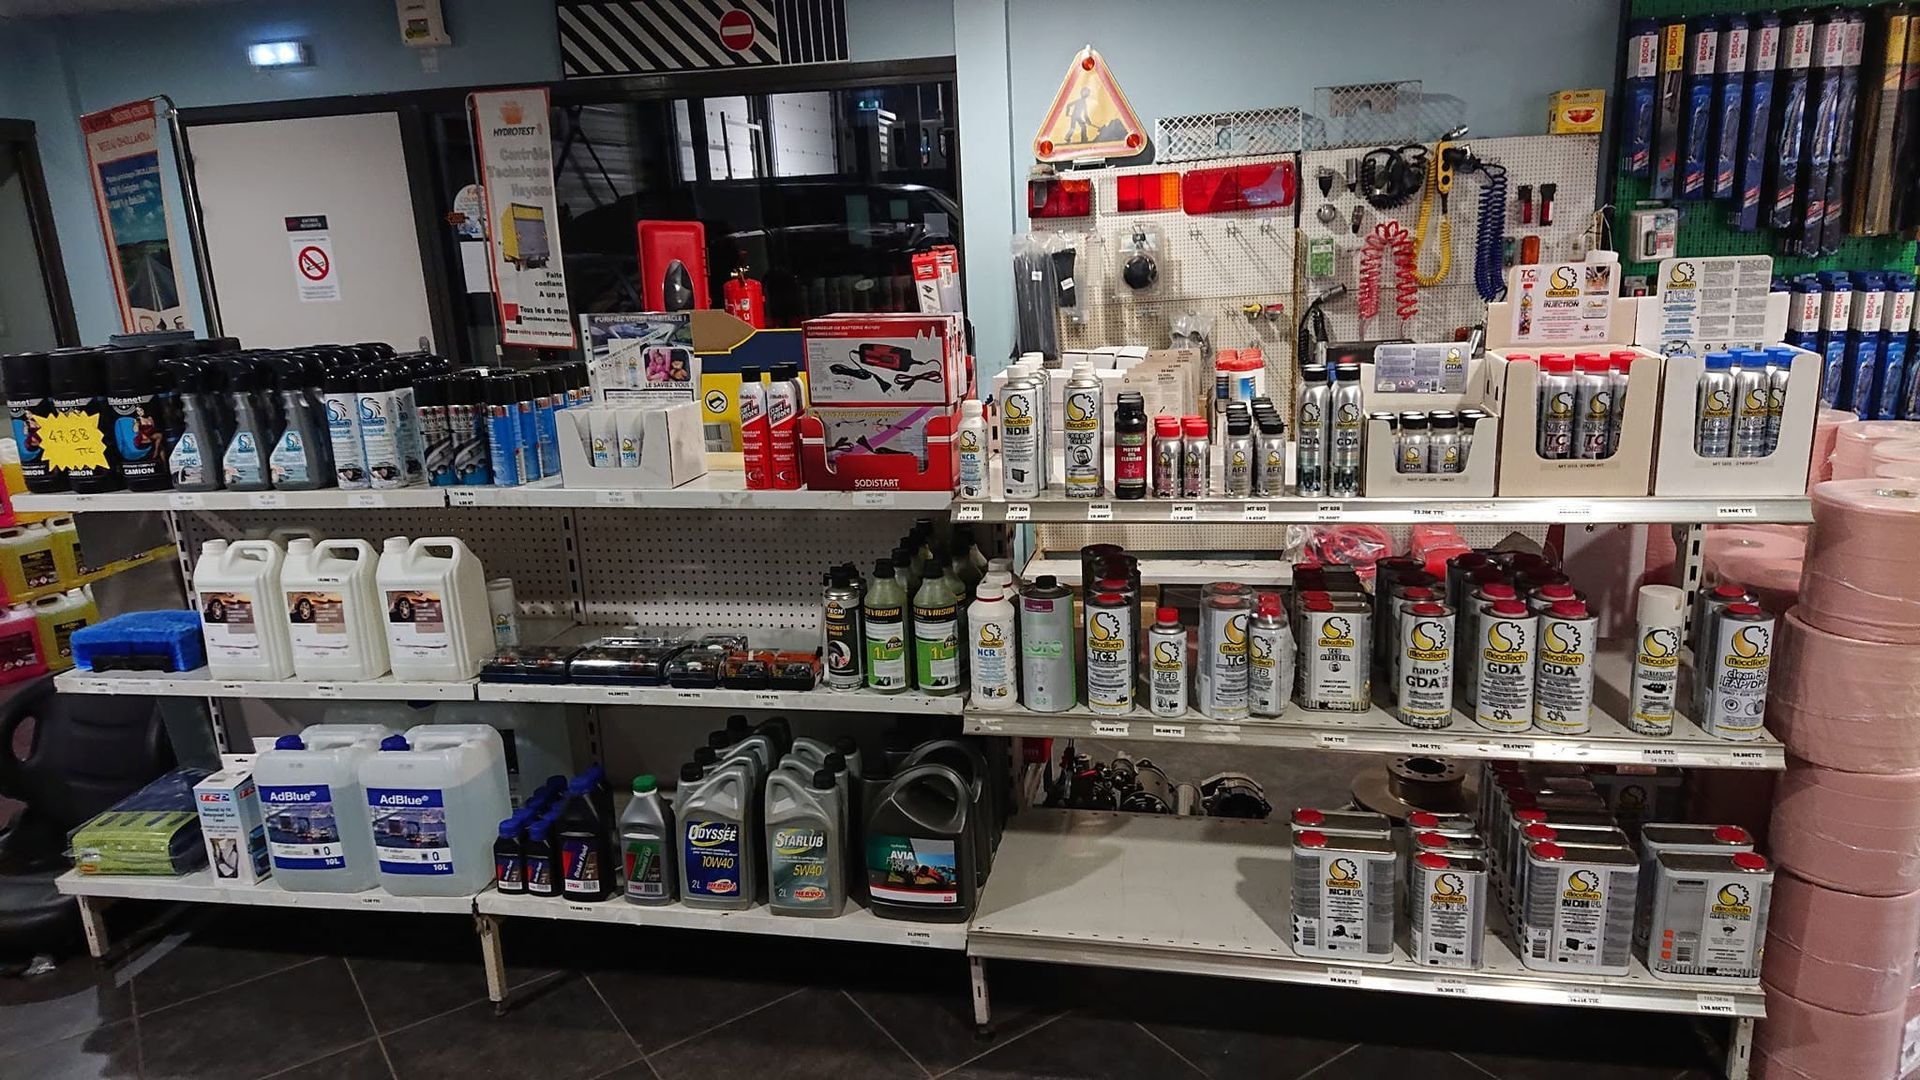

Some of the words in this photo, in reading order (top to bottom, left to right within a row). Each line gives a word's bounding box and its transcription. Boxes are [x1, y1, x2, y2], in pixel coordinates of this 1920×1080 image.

[1668, 24, 1677, 55] BOSCH
[1762, 29, 1771, 57] BOSCH
[1794, 26, 1805, 54] BOSCH
[1828, 24, 1838, 52] BOSCH
[1641, 37, 1650, 63] BOSCH
[1700, 34, 1709, 61] BOSCH
[1731, 32, 1740, 59] BOSCH
[493, 126, 536, 137] HYDROTEST
[1521, 269, 1535, 278] TC
[1543, 301, 1579, 309] INJECTION
[1806, 295, 1814, 320] BOSCH
[1835, 294, 1843, 319] BOSCH
[1866, 294, 1875, 319] BOSCH
[1895, 294, 1905, 319] BOSCH
[1006, 427, 1030, 436] NDH
[1299, 437, 1320, 446] GDA
[1336, 437, 1359, 447] GDA
[854, 478, 900, 488] SODISTART
[827, 607, 844, 615] TECH
[977, 648, 996, 657] NCR
[1093, 651, 1117, 662] TC3
[1409, 650, 1447, 660] MecaTech
[1485, 651, 1526, 662] MecaTech
[1541, 652, 1582, 663] MecaTech
[1640, 656, 1677, 665] MecaTech
[1727, 656, 1767, 666] MecaTech
[1412, 666, 1439, 675] nano
[1487, 663, 1522, 675] GDA
[1542, 664, 1576, 676] GDA
[1727, 669, 1756, 680] clean
[1156, 671, 1178, 681] TFB
[1406, 676, 1440, 689] GDA
[688, 823, 738, 842] ODYSSÉE
[774, 831, 824, 848] STARLUB
[890, 850, 914, 861] AVIA
[325, 858, 341, 866] 10L
[433, 863, 449, 871] 10L
[702, 855, 734, 870] 10W40
[792, 864, 823, 877] 5W40
[691, 879, 701, 889] 2L
[778, 888, 788, 898] 2L
[1328, 888, 1352, 896] NCH
[1561, 899, 1590, 908] NDH
